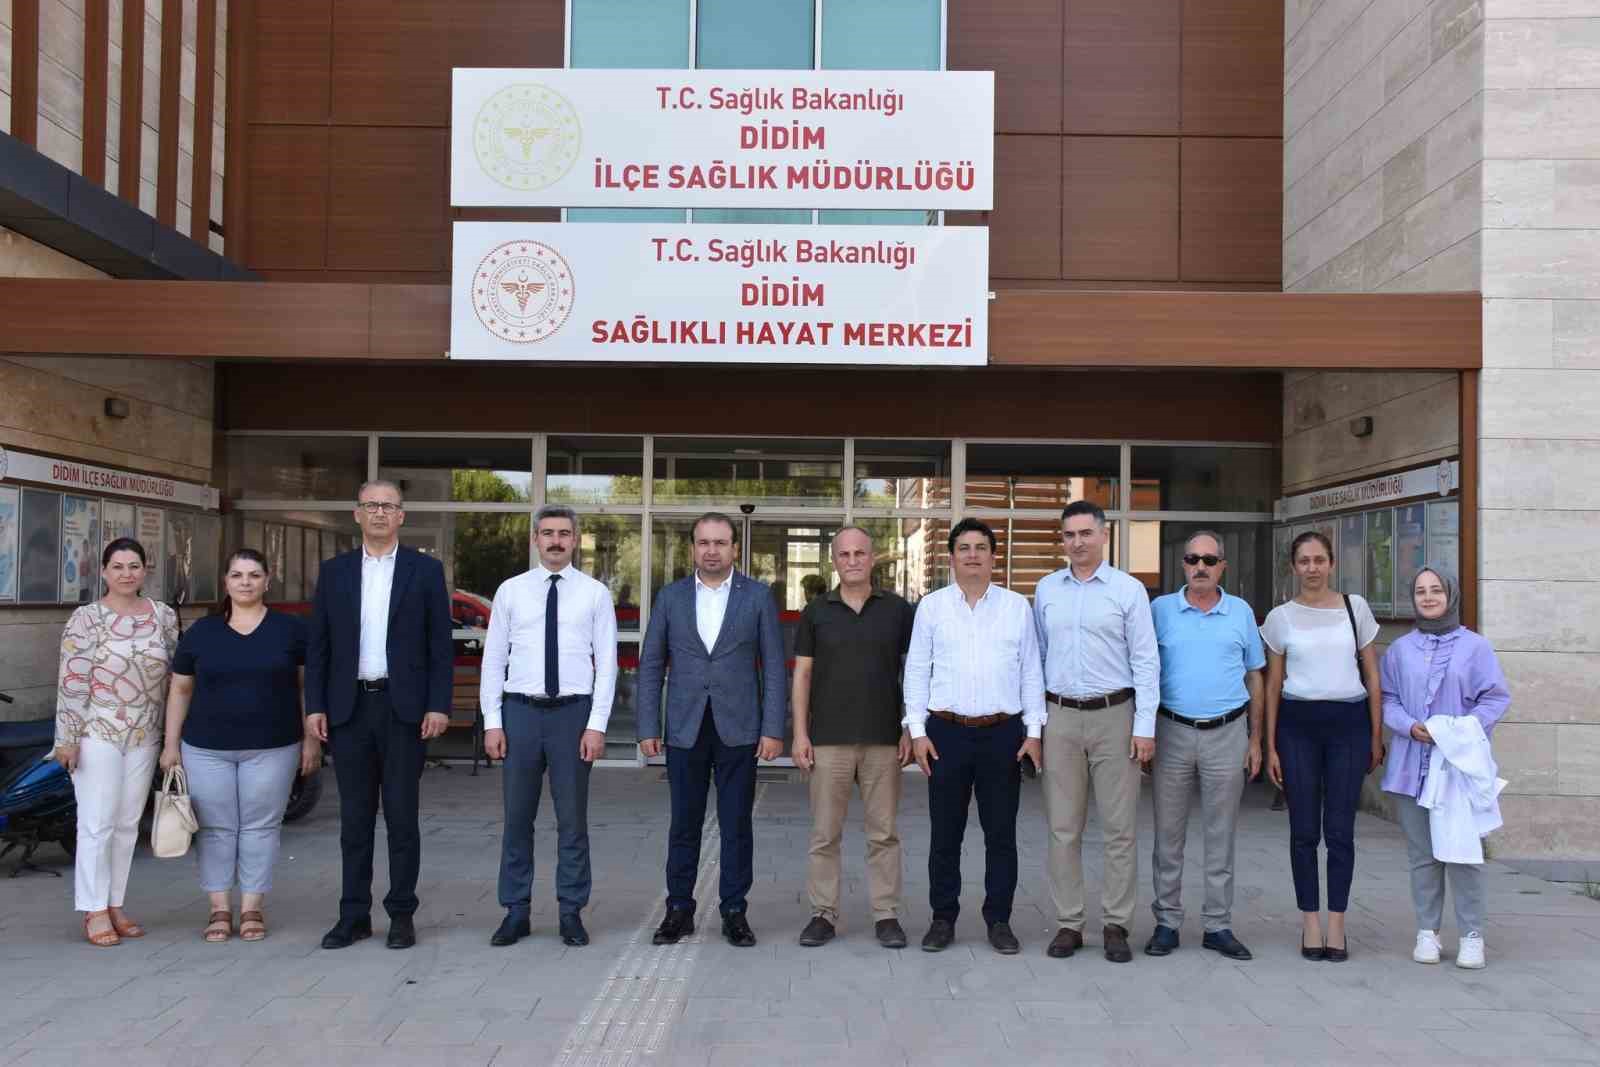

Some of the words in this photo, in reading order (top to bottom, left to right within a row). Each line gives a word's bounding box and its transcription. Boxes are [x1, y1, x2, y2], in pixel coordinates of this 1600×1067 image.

[656, 86, 703, 110] T.C.
[708, 87, 783, 116] Sağlık
[792, 87, 905, 117] Bakanlığı
[740, 119, 825, 150] DİDİM
[594, 158, 658, 192] İLÇE
[668, 160, 776, 190] SAĞLIK
[786, 159, 975, 193] MÜDÜRLÜĞÜ
[652, 238, 699, 262] T.C.
[708, 239, 786, 269] Sağlık
[796, 239, 916, 270] Bakanlığı
[741, 275, 825, 307] DİDİM
[591, 314, 726, 345] SAĞLIKLI
[736, 321, 833, 346] HAYAT
[843, 318, 973, 348] MERKEZİ
